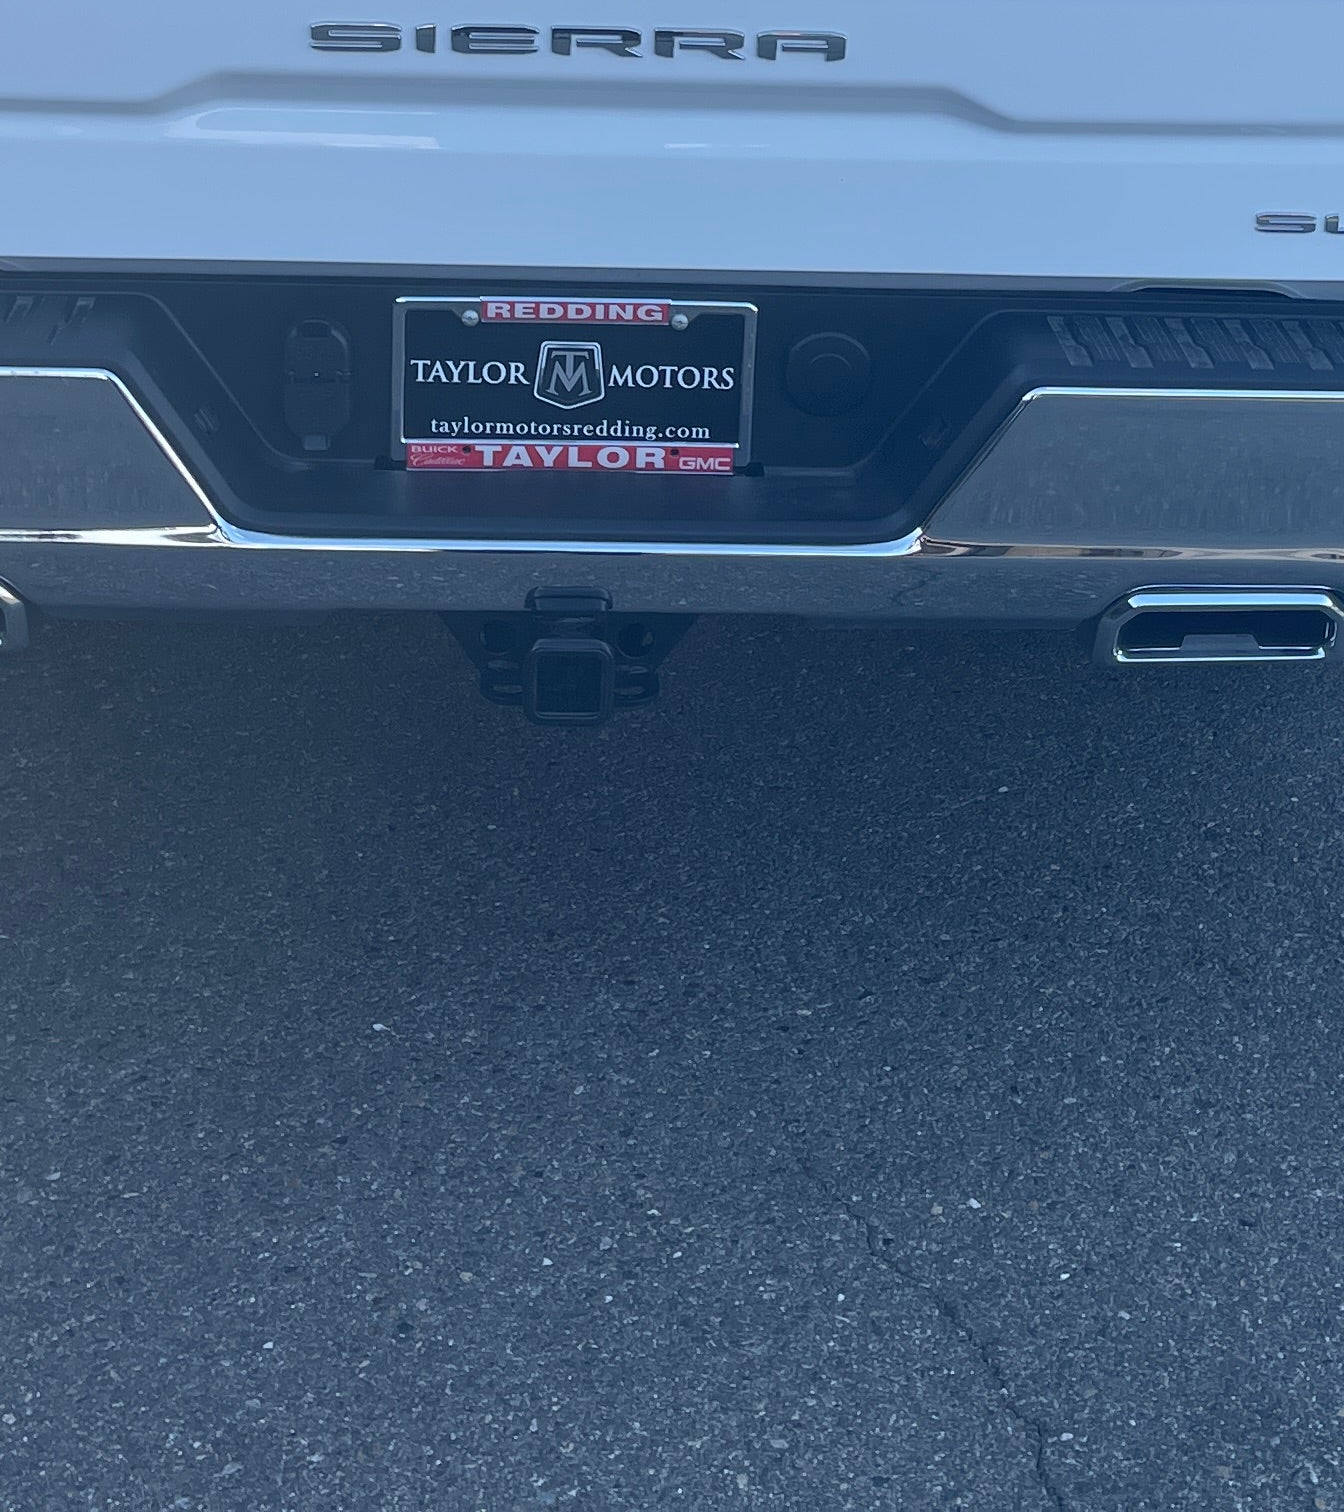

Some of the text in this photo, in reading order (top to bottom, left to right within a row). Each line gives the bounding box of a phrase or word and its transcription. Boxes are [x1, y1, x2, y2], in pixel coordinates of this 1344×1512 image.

[309, 21, 848, 62] SIERRA
[486, 302, 664, 322] REDDING
[410, 359, 530, 386] TAYLOR
[607, 364, 735, 391] MOTORS
[430, 416, 711, 442] taylormotorsredding.com
[410, 444, 459, 455] BUICK
[473, 444, 666, 470] TAYLOR
[678, 456, 731, 471] GMC
